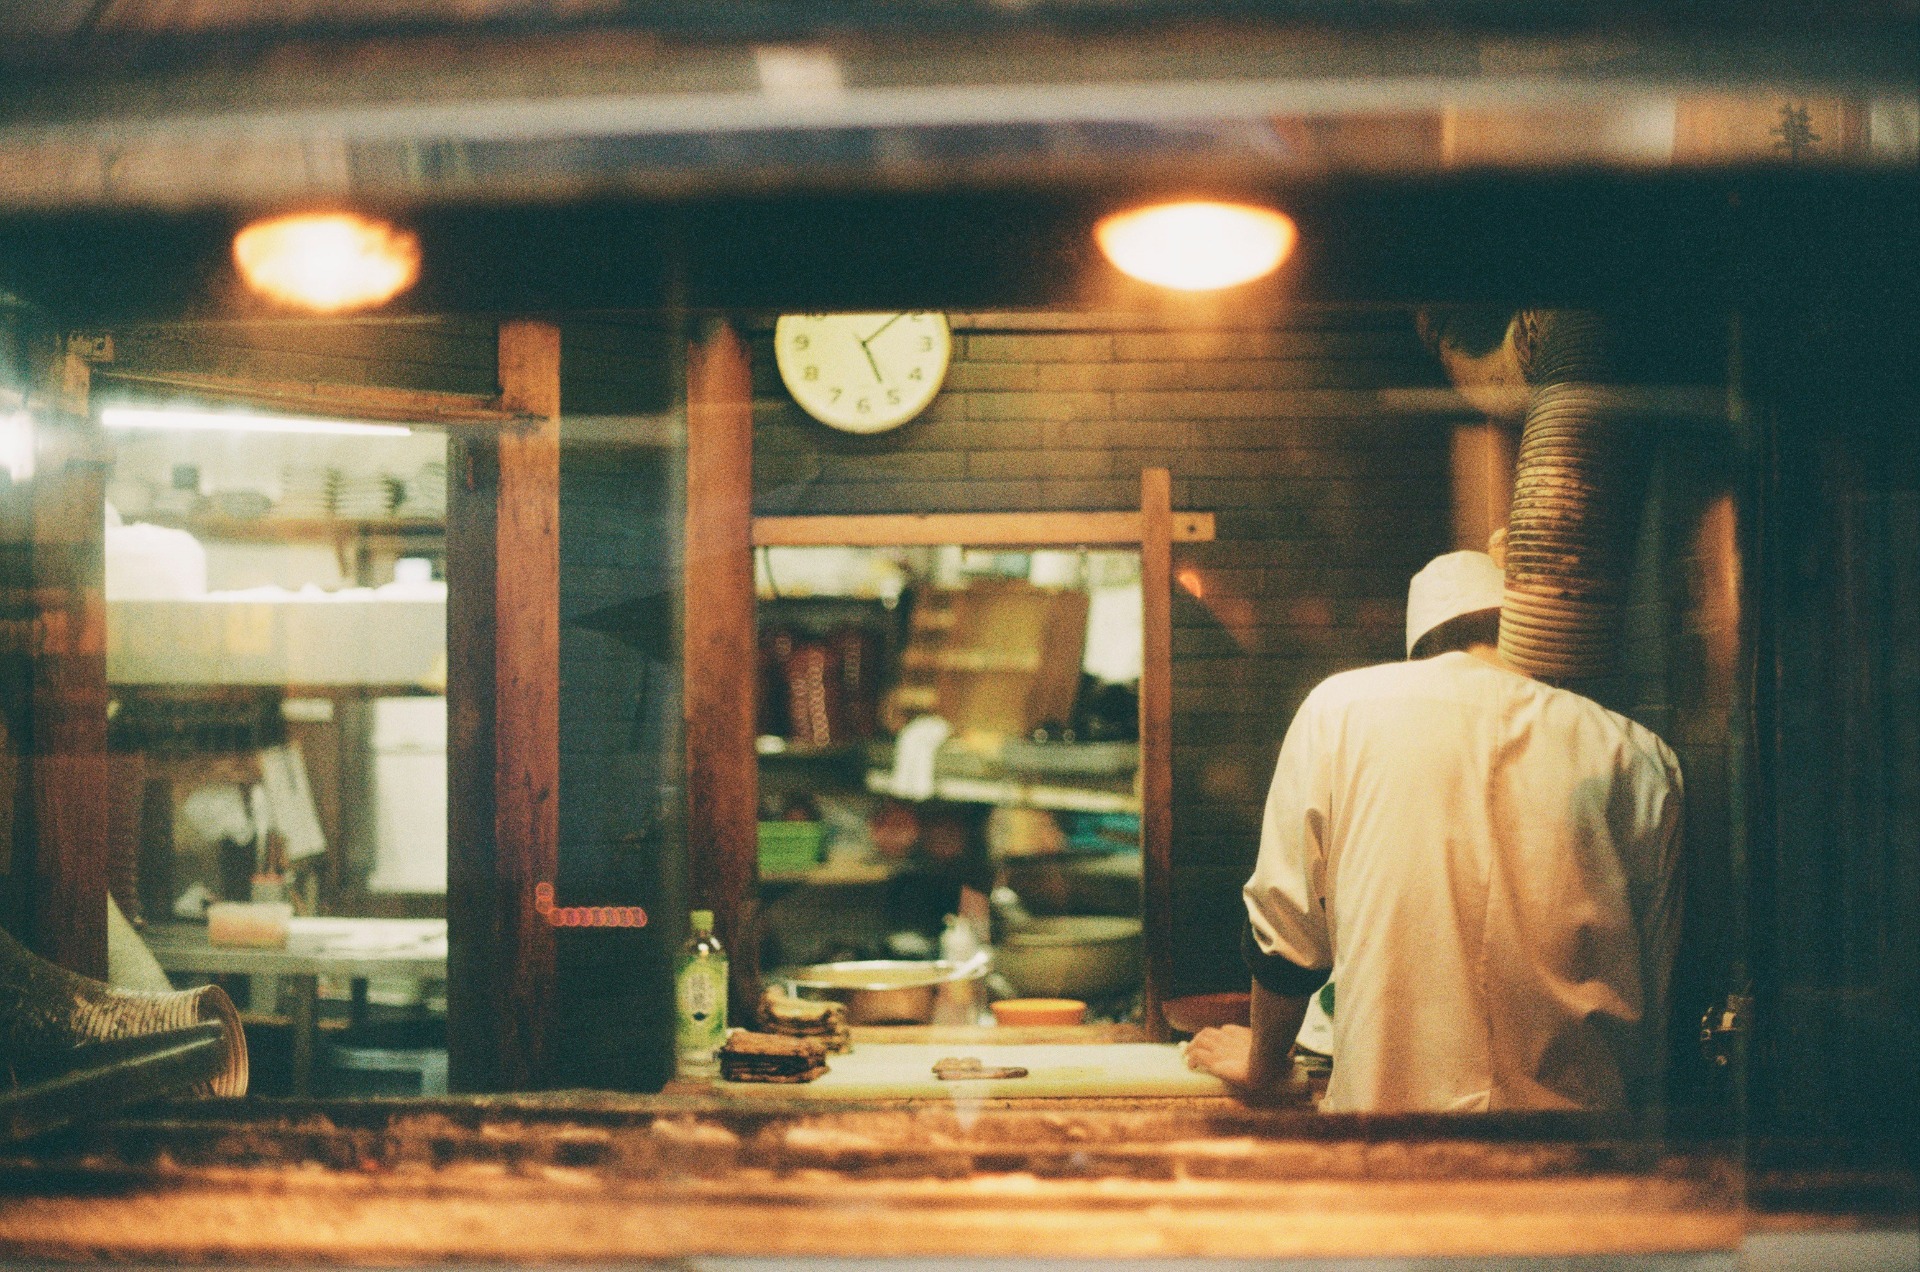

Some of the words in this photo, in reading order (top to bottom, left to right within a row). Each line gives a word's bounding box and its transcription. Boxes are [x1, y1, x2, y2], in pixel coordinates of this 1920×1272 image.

[794, 334, 810, 350] 9
[920, 336, 933, 351] 3
[908, 366, 923, 381] 4
[830, 388, 842, 404] 7
[887, 388, 901, 405] 5
[857, 398, 871, 413] 6
